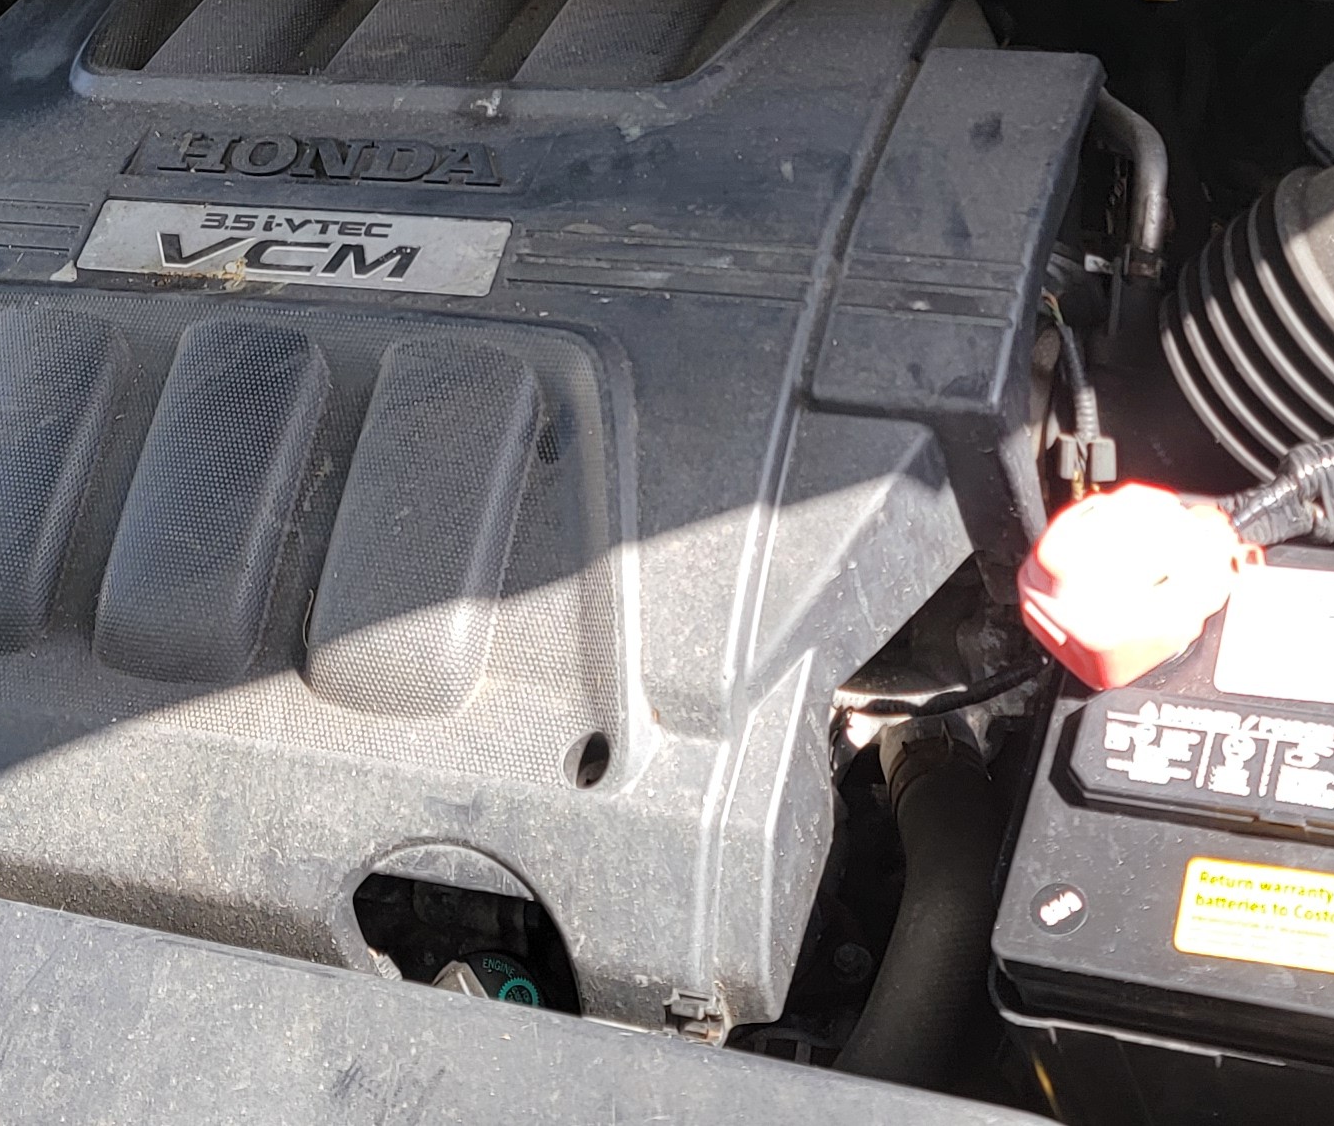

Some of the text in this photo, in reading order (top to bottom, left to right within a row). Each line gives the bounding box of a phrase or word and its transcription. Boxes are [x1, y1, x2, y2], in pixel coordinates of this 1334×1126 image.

[157, 131, 503, 188] HONDA
[200, 211, 394, 239] 3.5 i-VTEC
[157, 231, 422, 283] VCM
[1199, 870, 1254, 890] Return
[1259, 881, 1334, 904] warranty
[1195, 893, 1266, 915] batteries
[1273, 903, 1288, 917] to
[481, 957, 515, 978] ENGINE
